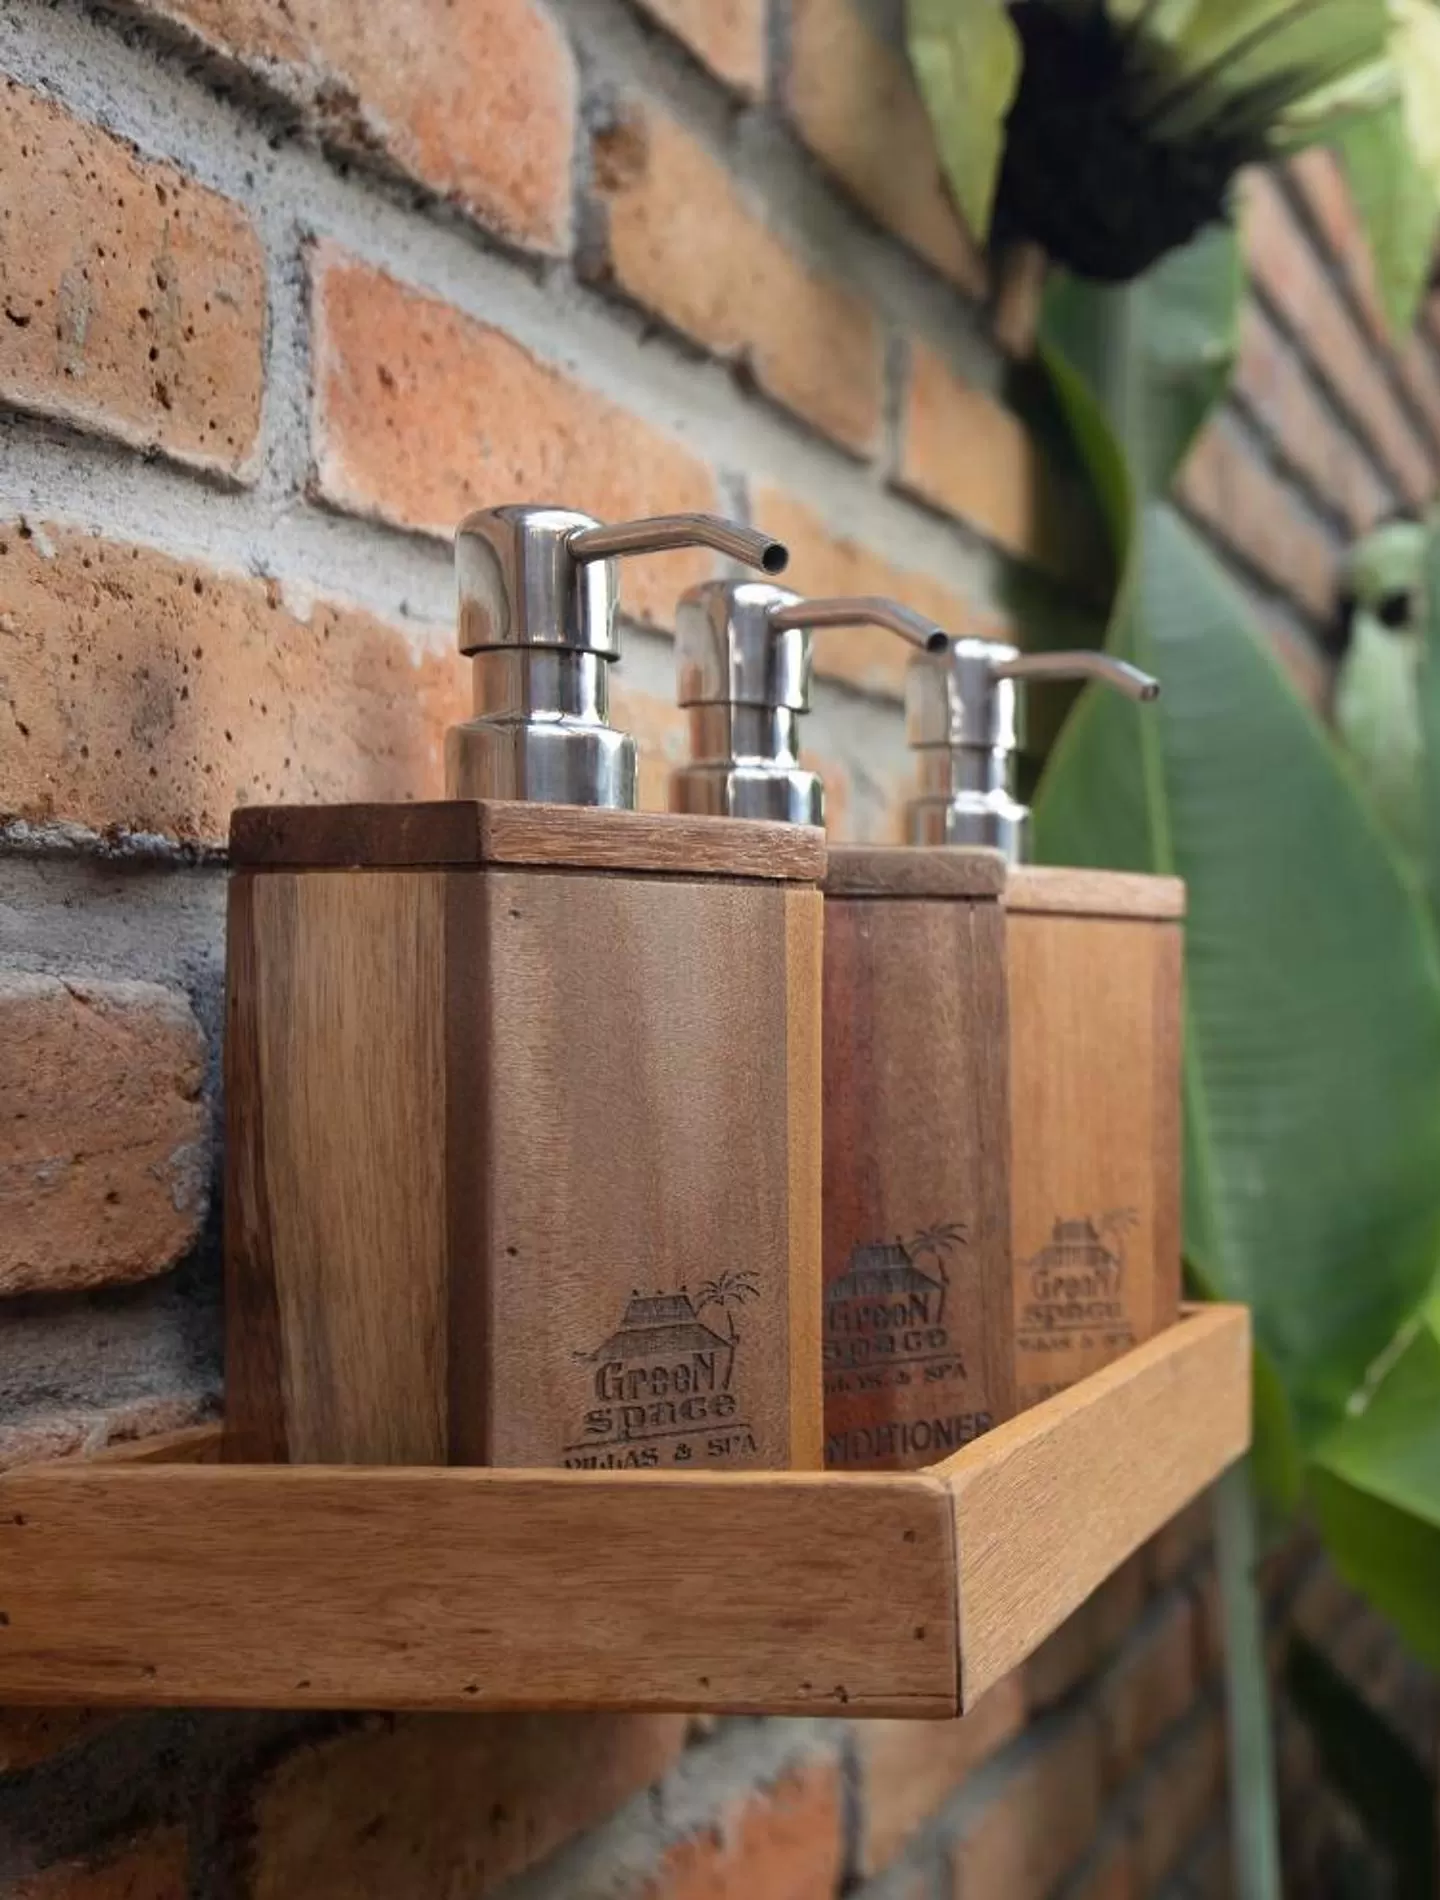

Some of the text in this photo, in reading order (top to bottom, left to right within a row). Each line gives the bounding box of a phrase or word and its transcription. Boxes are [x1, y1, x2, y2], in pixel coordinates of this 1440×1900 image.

[674, 1443, 692, 1461] &
[707, 1435, 758, 1456] SPA
[827, 1411, 993, 1463] NDITIONER
